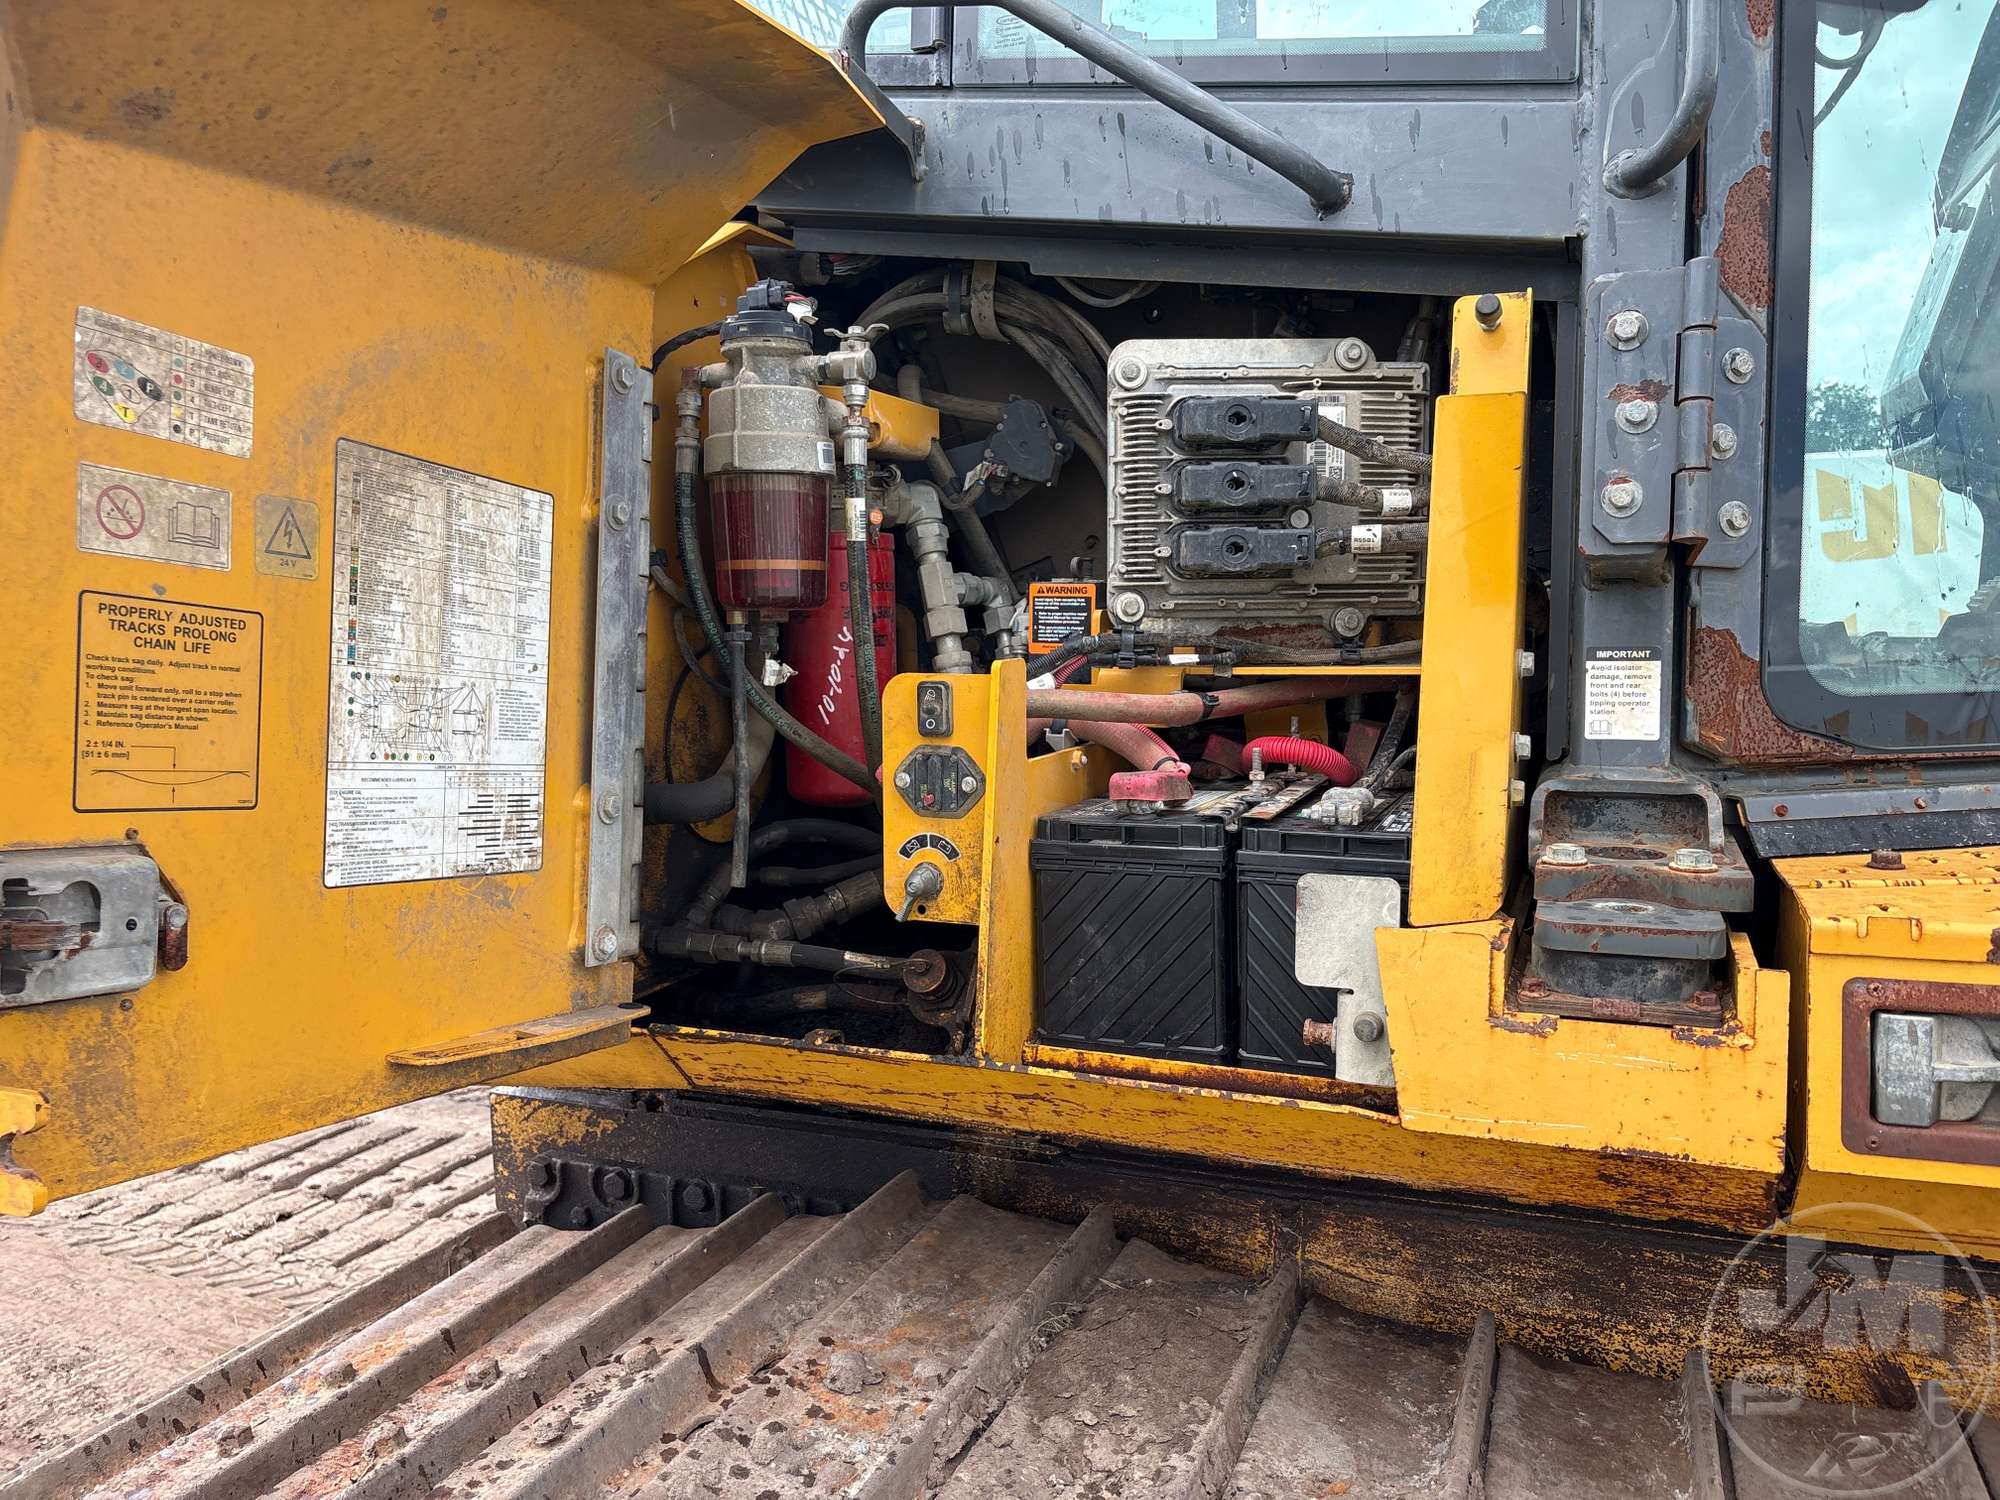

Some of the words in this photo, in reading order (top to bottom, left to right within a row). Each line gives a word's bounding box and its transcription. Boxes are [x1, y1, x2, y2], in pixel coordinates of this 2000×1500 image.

[122, 407, 129, 417] T
[280, 558, 290, 567] 24
[290, 560, 296, 568] V
[98, 602, 172, 622] PROPERLY
[179, 613, 246, 630] ADJUSTED
[108, 618, 166, 635] TRACKS
[174, 626, 237, 643] PROLONG
[134, 637, 176, 650] CHAIN
[184, 642, 211, 654] LIFE
[146, 658, 166, 668] daily.
[85, 664, 116, 672] working
[118, 666, 156, 674] conditions.
[96, 720, 133, 728] Reference
[135, 721, 172, 729] Operator's
[81, 750, 94, 759] [51
[111, 751, 130, 760] mm]
